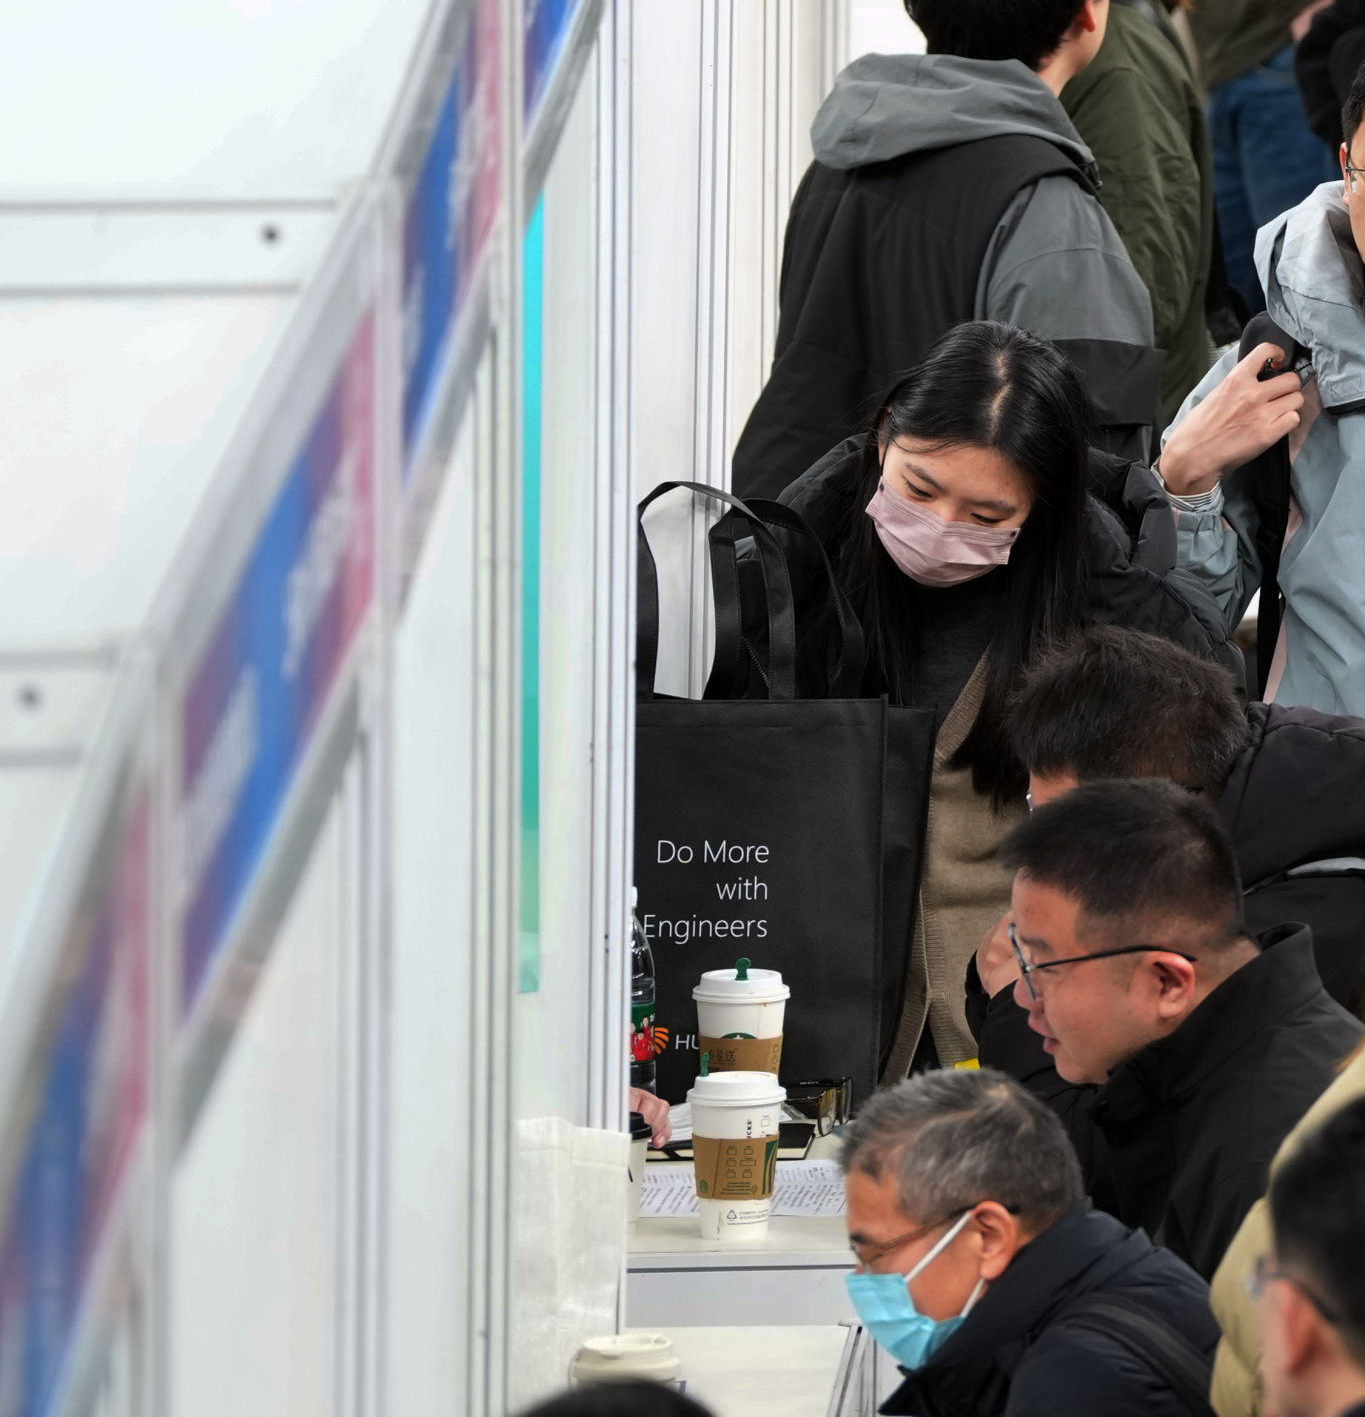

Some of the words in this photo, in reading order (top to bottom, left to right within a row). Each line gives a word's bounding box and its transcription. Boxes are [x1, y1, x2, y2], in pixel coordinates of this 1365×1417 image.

[657, 839, 694, 864] Do
[703, 839, 770, 864] More
[716, 875, 768, 901] with
[643, 914, 768, 946] Engineers
